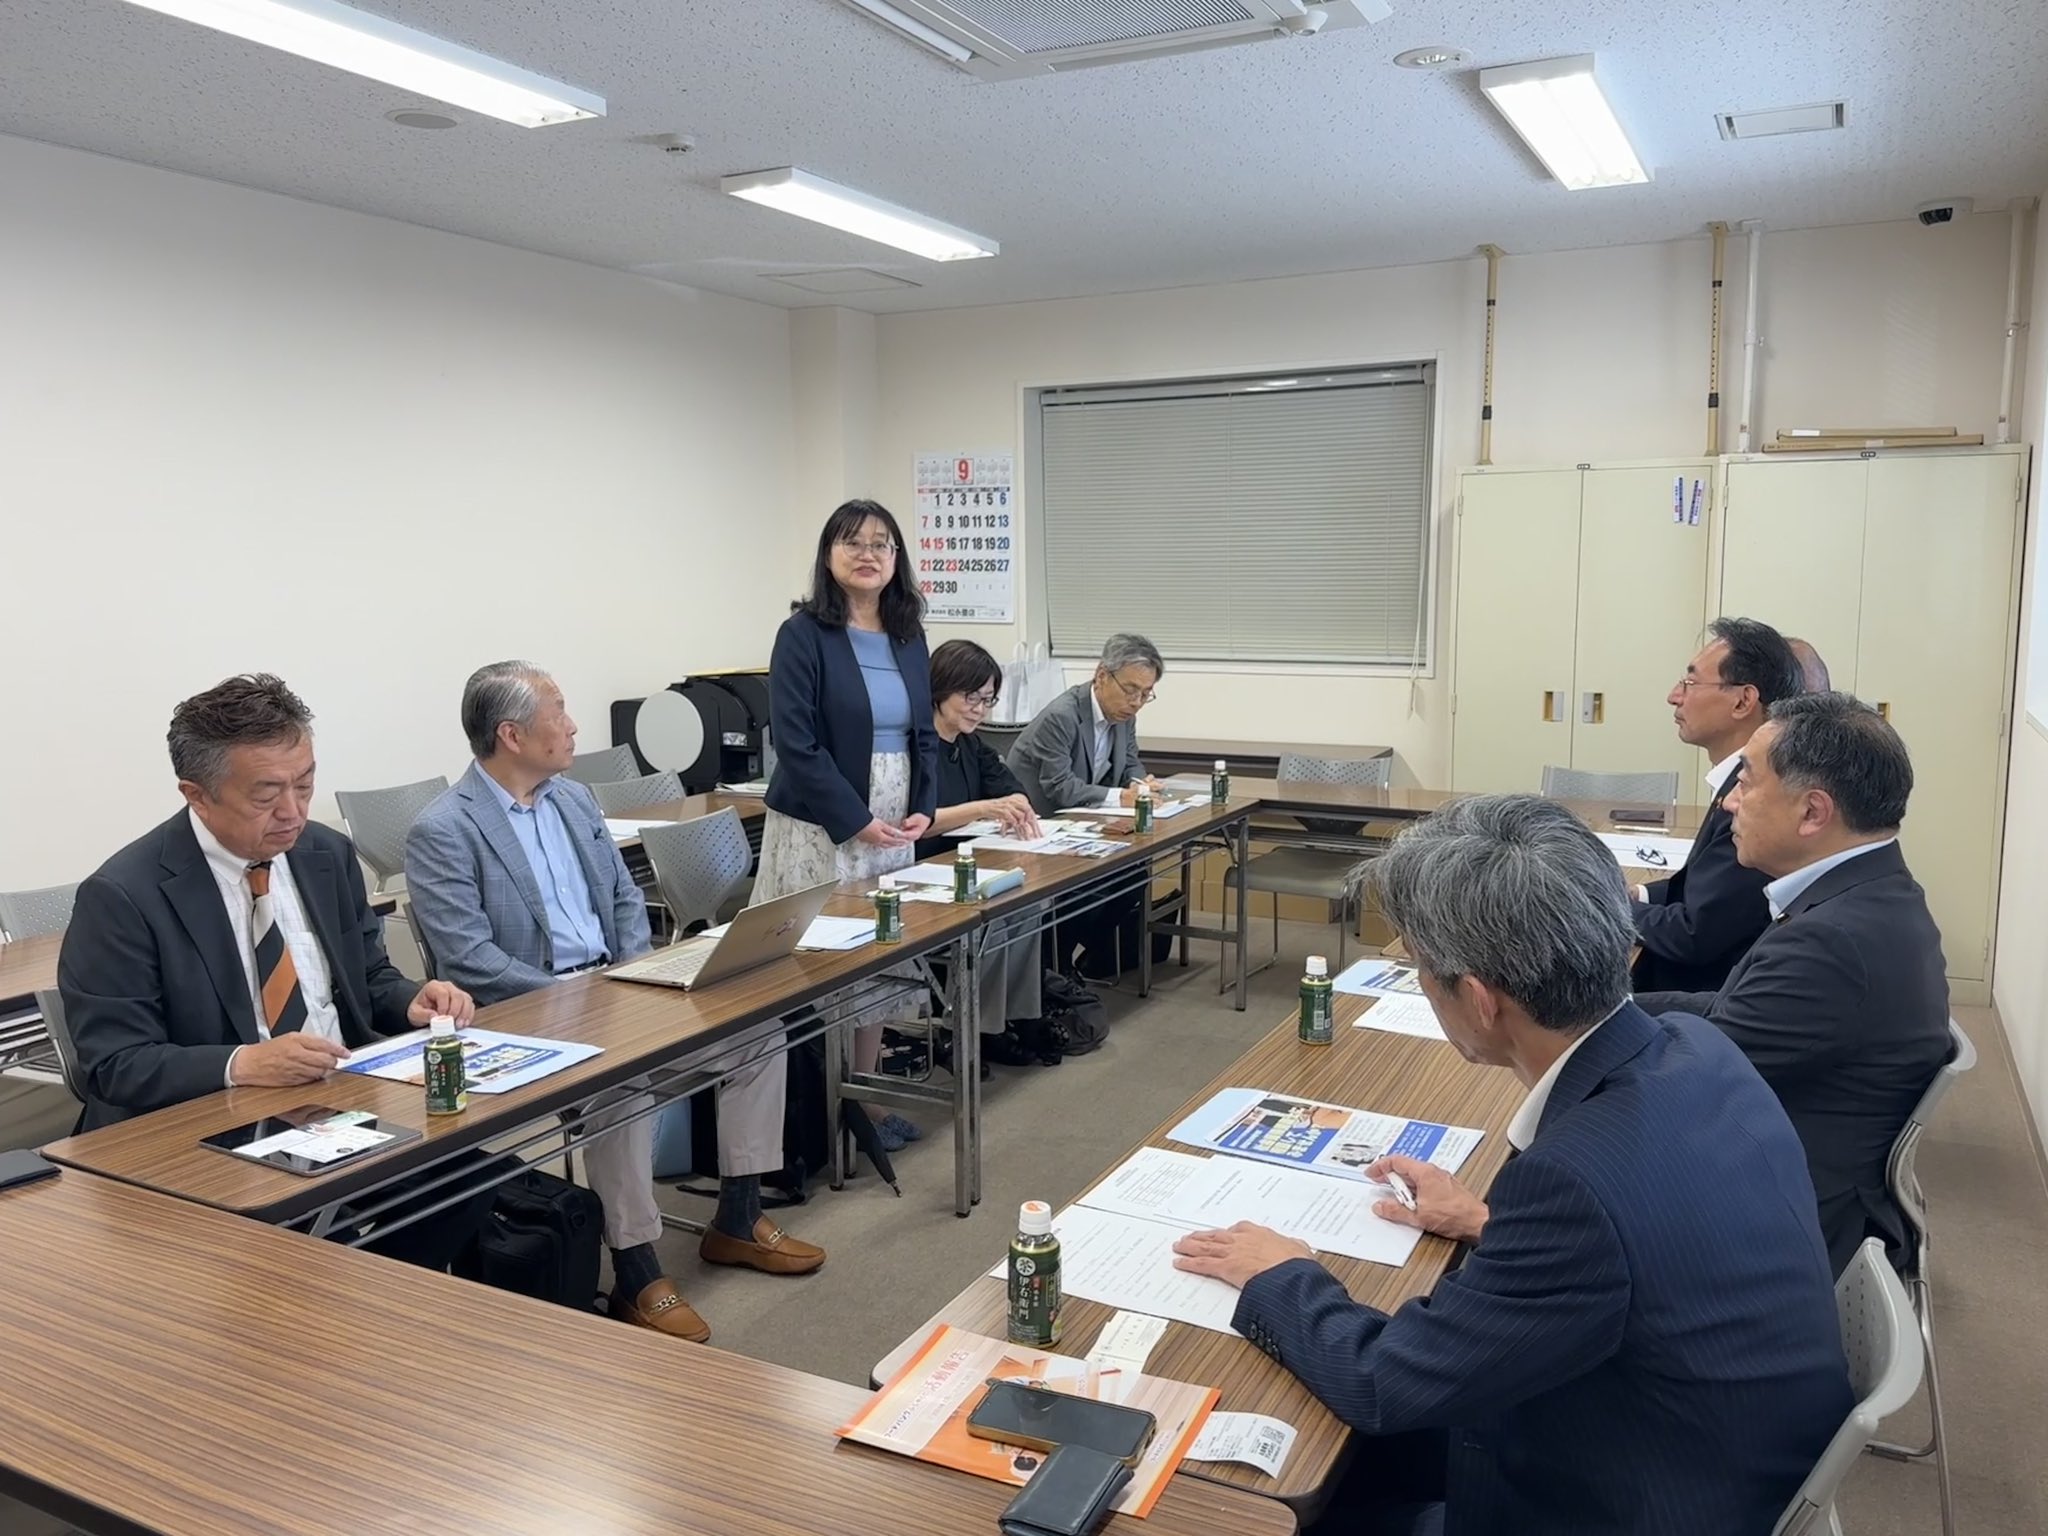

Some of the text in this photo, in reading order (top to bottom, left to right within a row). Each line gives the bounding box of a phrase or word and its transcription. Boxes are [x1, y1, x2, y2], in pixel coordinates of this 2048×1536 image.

[958, 459, 969, 480] 9
[935, 492, 1007, 506] 1 2 3 4 5 6
[922, 515, 1009, 528] 7 8 9 10 11 12 13
[920, 537, 1010, 550] 14 15 16 17 18 19 20
[920, 559, 1010, 572] 21 22 23 24 25 26 27
[920, 581, 932, 593] 28
[932, 581, 944, 593] 29
[945, 581, 957, 593] 30
